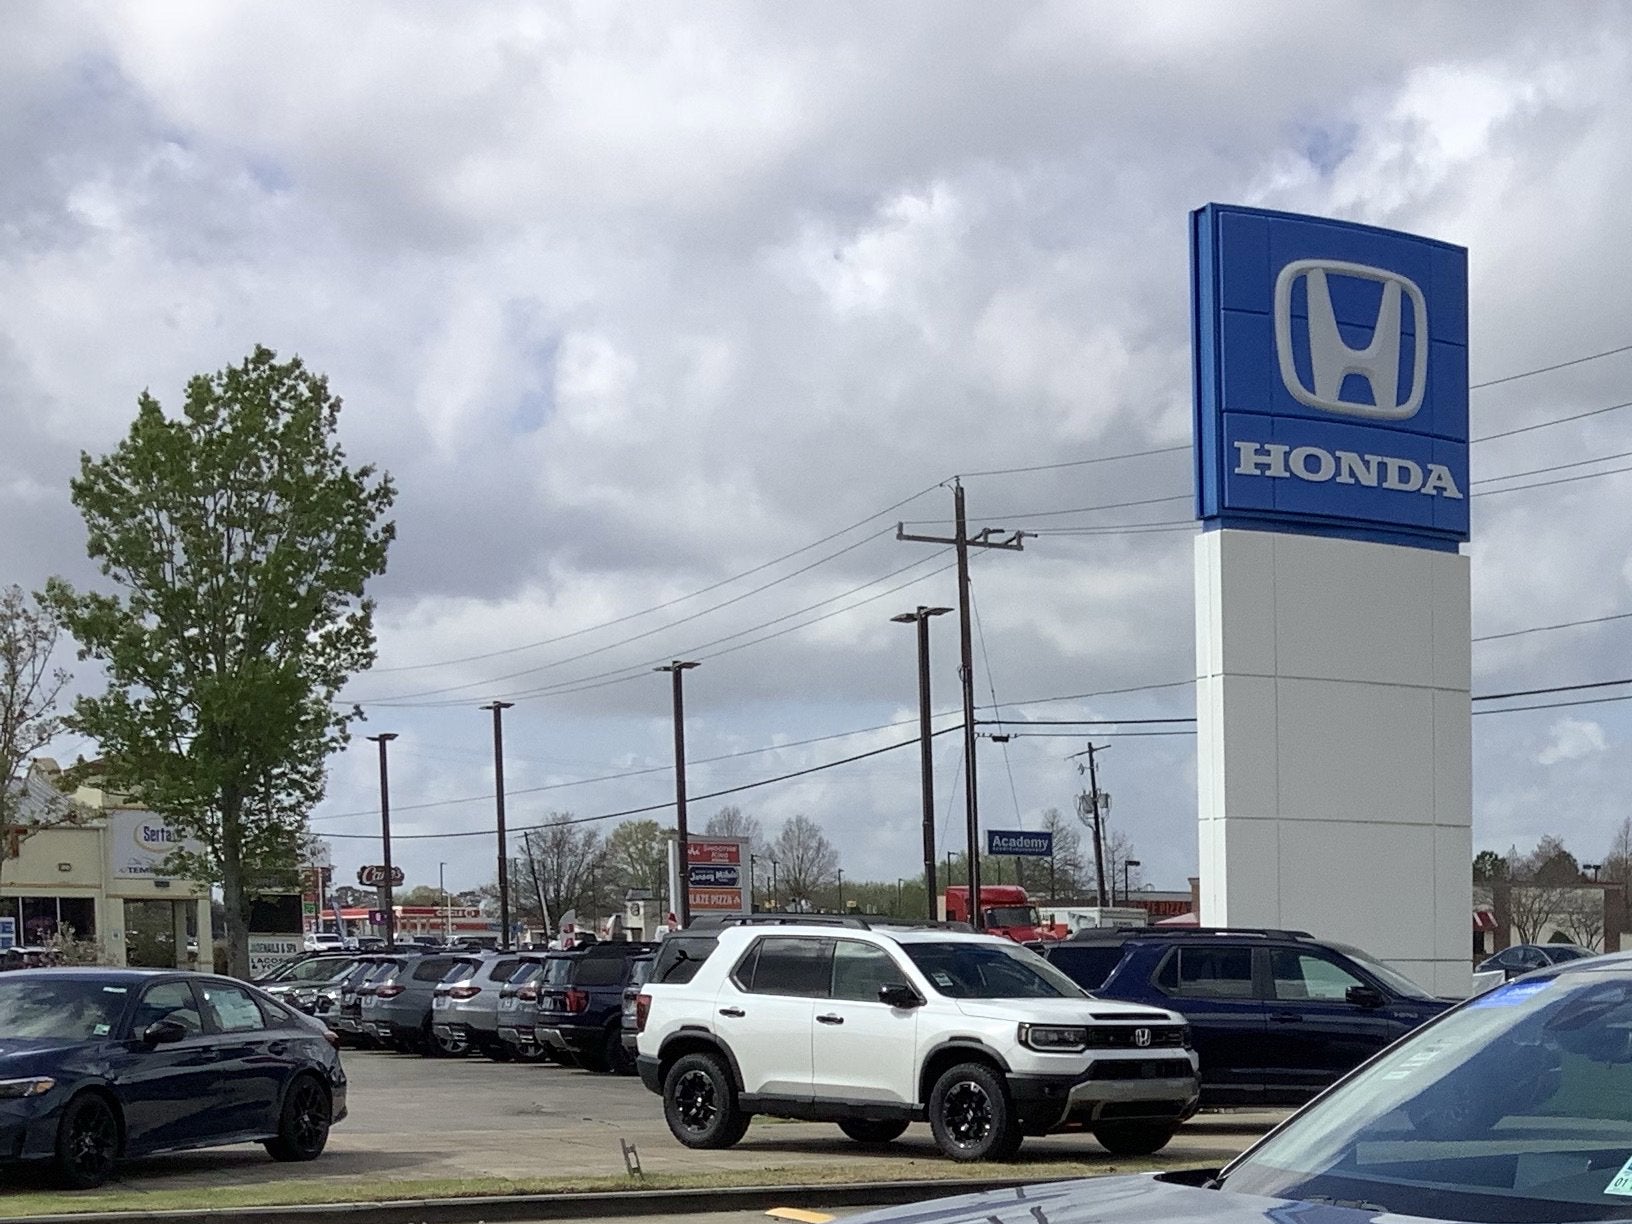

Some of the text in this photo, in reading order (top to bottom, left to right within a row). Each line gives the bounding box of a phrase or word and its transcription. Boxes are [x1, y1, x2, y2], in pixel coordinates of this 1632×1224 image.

[1234, 441, 1463, 500] HONDA
[143, 826, 172, 842] Serta
[992, 836, 1049, 850] Academy
[711, 894, 732, 904] PIZZA
